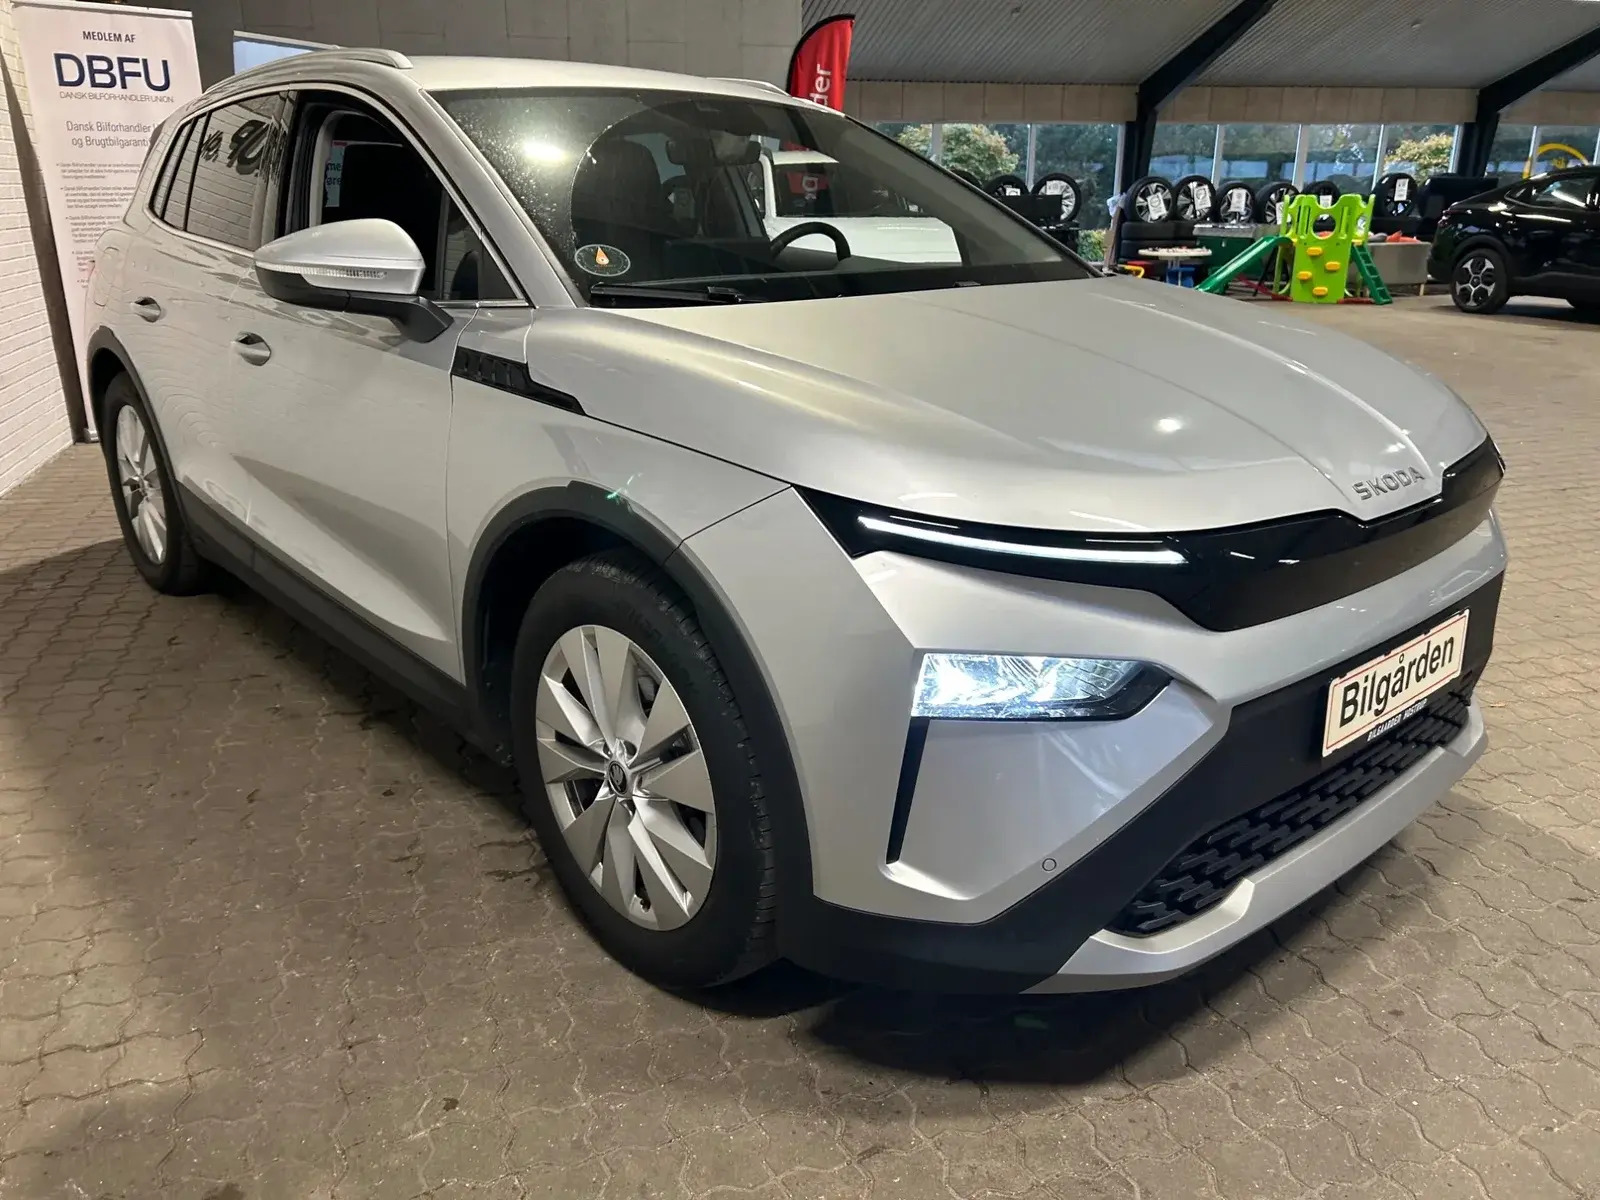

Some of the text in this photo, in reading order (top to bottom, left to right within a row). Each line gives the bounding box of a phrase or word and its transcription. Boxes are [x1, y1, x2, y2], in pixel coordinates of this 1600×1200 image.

[82, 30, 137, 43] MEDLEM AF
[53, 52, 171, 92] DBFU
[59, 91, 174, 103] DANSK BILFORHANDLER UNION
[66, 120, 95, 132] Dansk
[96, 121, 151, 133] Bilforhandler
[71, 137, 83, 149] og
[1339, 636, 1454, 728] Bilgården
